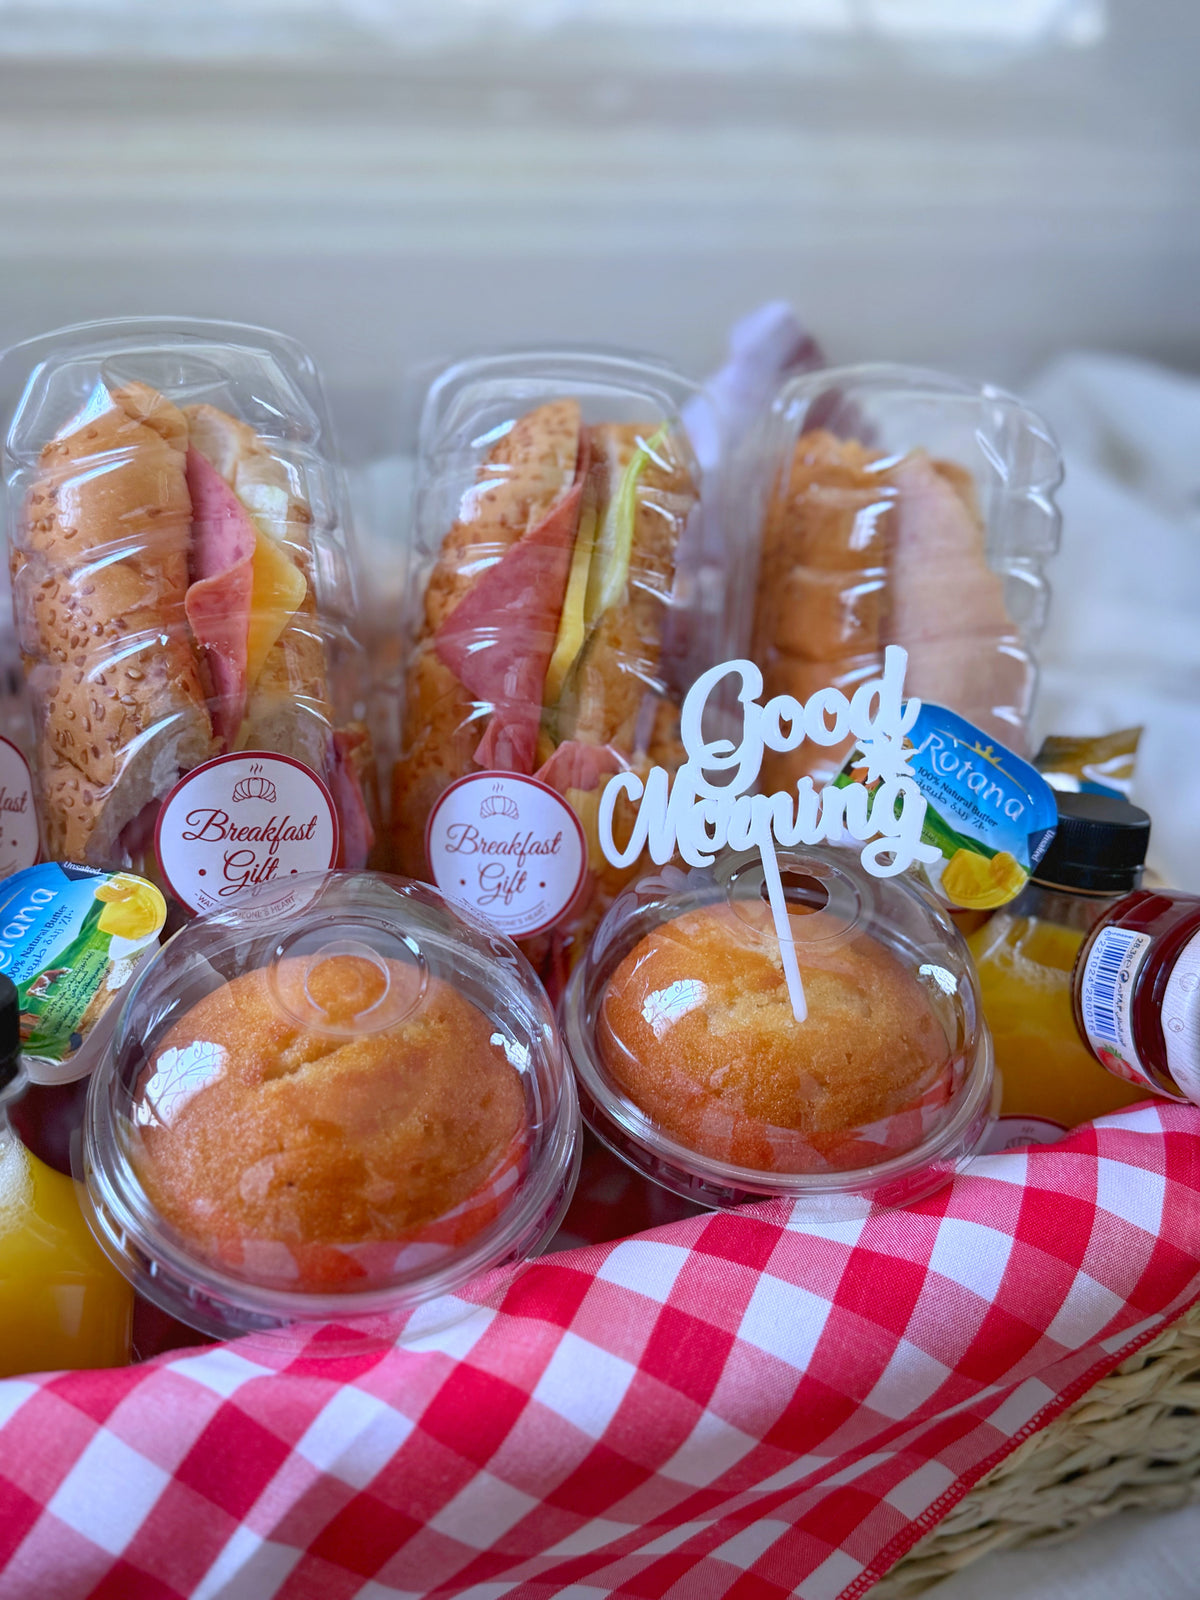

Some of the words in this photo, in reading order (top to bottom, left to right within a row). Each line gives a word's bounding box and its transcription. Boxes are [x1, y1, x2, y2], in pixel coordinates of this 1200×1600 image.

[680, 645, 922, 799] Good
[918, 732, 1025, 822] Rotana
[918, 766, 940, 786] 100%
[940, 782, 974, 810] Natural
[971, 803, 999, 828] Butter
[182, 808, 318, 855] Breakfast
[445, 823, 562, 868] Breakfast
[598, 764, 943, 878] Morning
[1031, 829, 1056, 863] Unsalted
[218, 849, 280, 897] Gift
[477, 861, 527, 906] Gift
[7, 960, 26, 980] 00%
[20, 928, 49, 958] Natural
[44, 904, 68, 929] Butter
